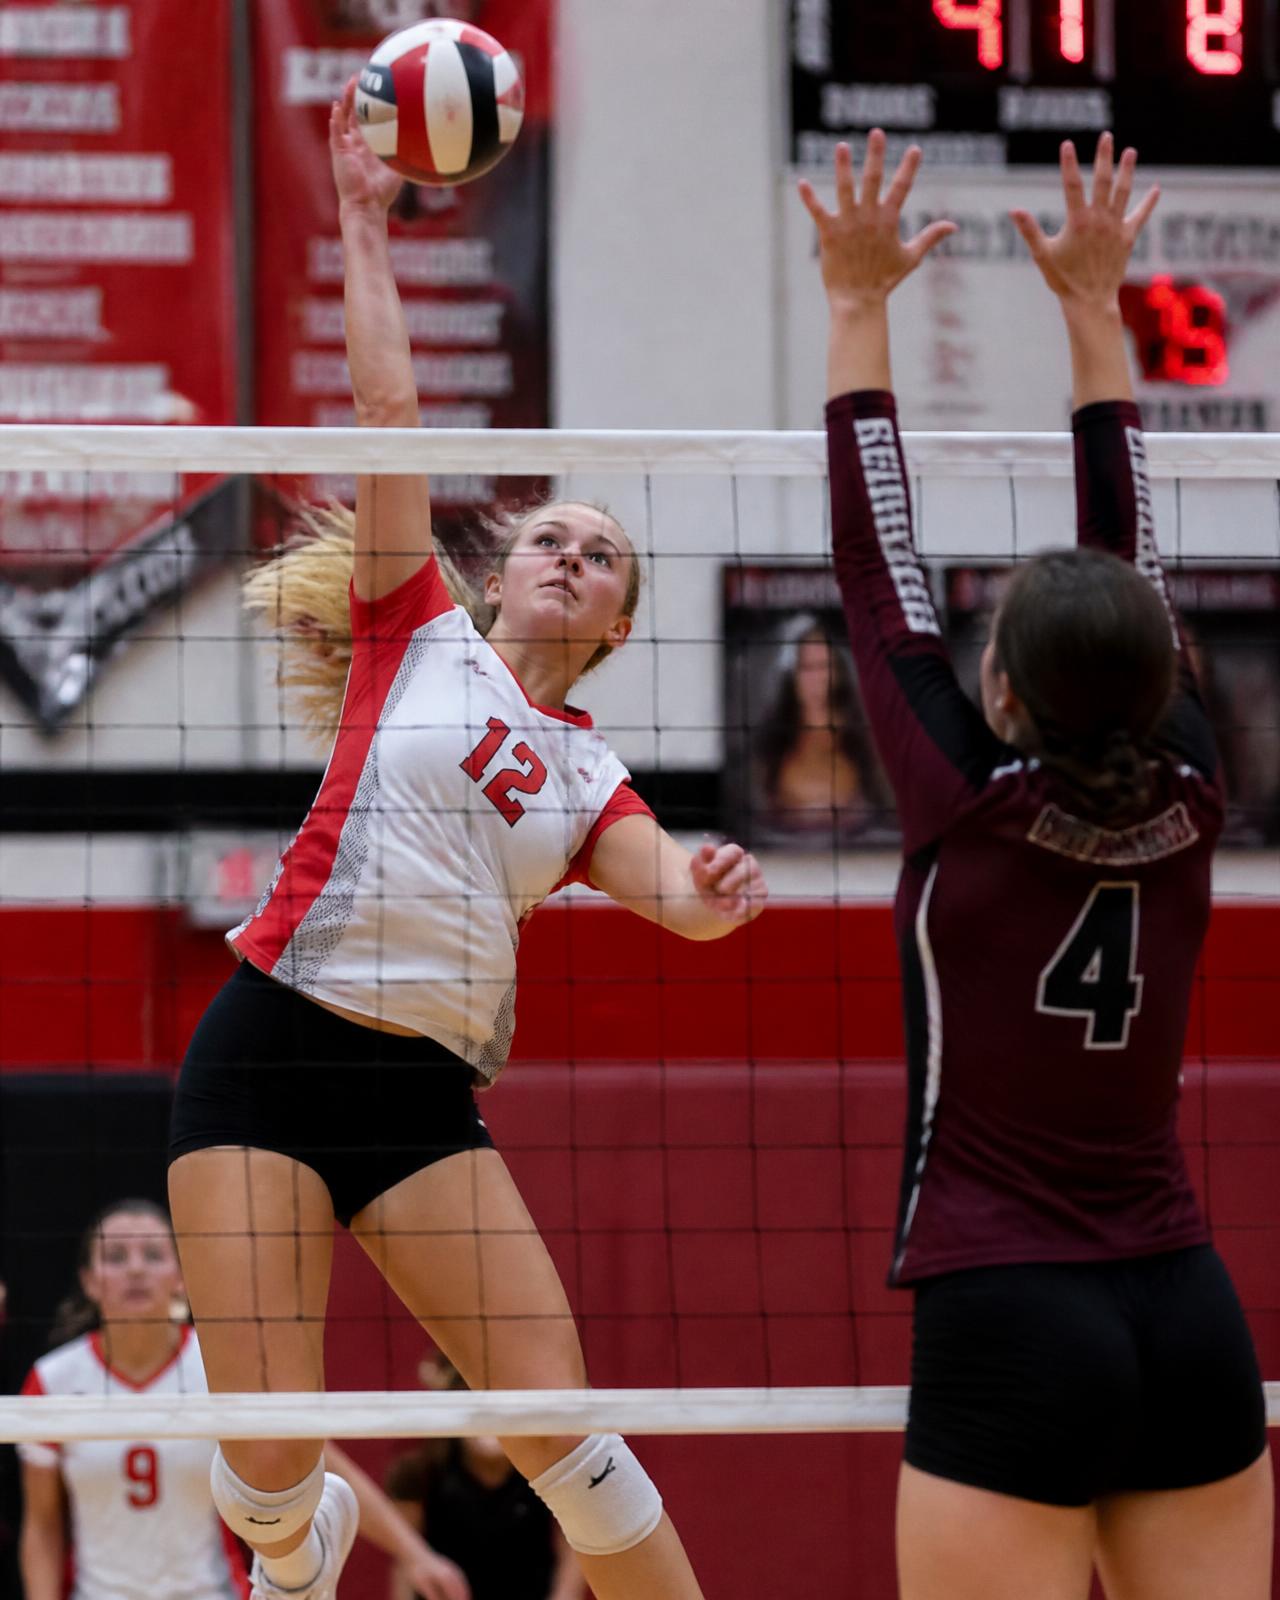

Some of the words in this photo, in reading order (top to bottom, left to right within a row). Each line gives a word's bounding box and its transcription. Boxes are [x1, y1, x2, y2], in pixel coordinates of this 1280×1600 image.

[459, 717, 547, 828] 12
[1035, 881, 1144, 1050] 4
[123, 1447, 162, 1512] 9
